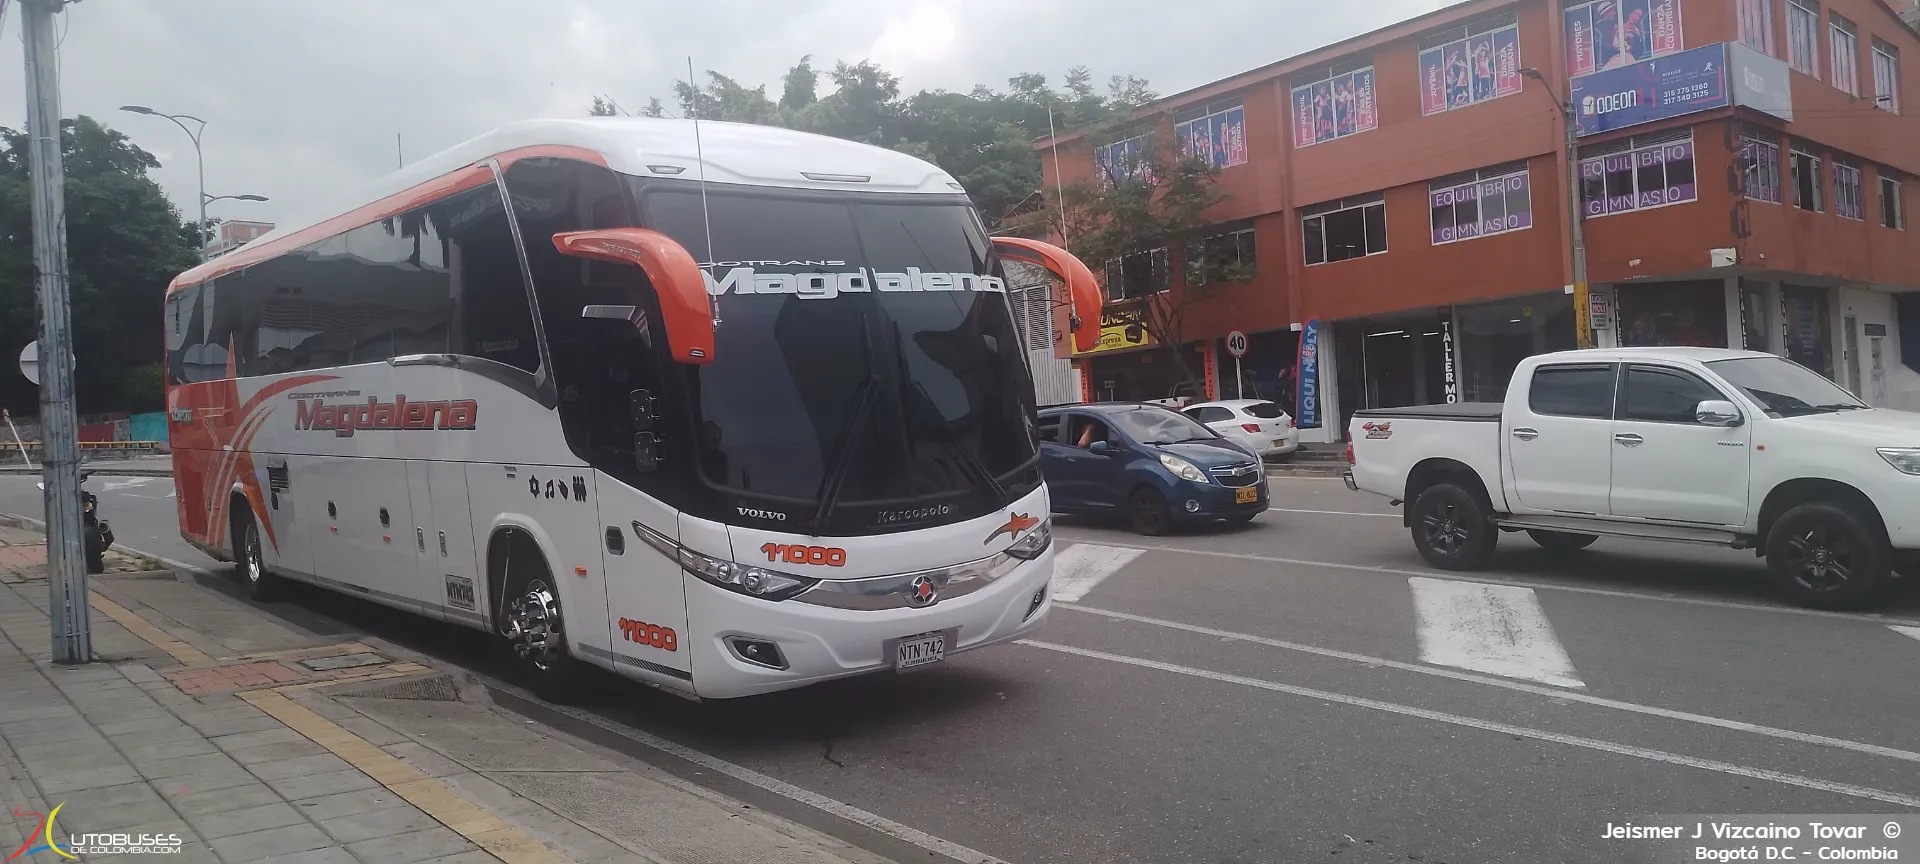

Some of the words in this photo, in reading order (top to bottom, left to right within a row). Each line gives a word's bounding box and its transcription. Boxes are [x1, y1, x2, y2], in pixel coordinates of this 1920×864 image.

[1657, 4, 1665, 37] DANZA
[1664, 0, 1675, 49] COLOMBIA
[1574, 20, 1584, 62] MAYORES
[1500, 46, 1508, 77] DANZA
[1507, 41, 1515, 78] URBANA
[1429, 64, 1437, 97] JUVENIL
[1663, 90, 1675, 98] 315
[1676, 86, 1690, 95] 775
[1690, 82, 1709, 92] 1360
[1364, 74, 1373, 124] ZAPATEADOS
[1596, 89, 1637, 115] ODEON
[1663, 97, 1676, 105] 317
[1692, 90, 1709, 99] 3125
[1583, 145, 1685, 177] EQUILIBRIO
[1435, 177, 1522, 206] EQUILIBRIO
[1589, 186, 1681, 214] GIMNASIO
[1441, 214, 1518, 240] GIMNASIO
[697, 260, 846, 268] OOTRANS
[700, 266, 1006, 300] Magdalena
[1100, 308, 1142, 327] UNCAN
[1739, 288, 1748, 350] TALLE
[1230, 335, 1245, 350] 40
[1302, 324, 1318, 373] MLY
[288, 390, 361, 400] COOTRANS
[1303, 378, 1316, 425] LIQUI
[295, 394, 478, 437] Magdalena
[737, 506, 787, 521] VOLVO
[877, 503, 949, 524] Marcopolo
[760, 542, 846, 567] 11000
[618, 616, 678, 652] 11000
[899, 643, 921, 662] NTN
[923, 639, 943, 656] 742
